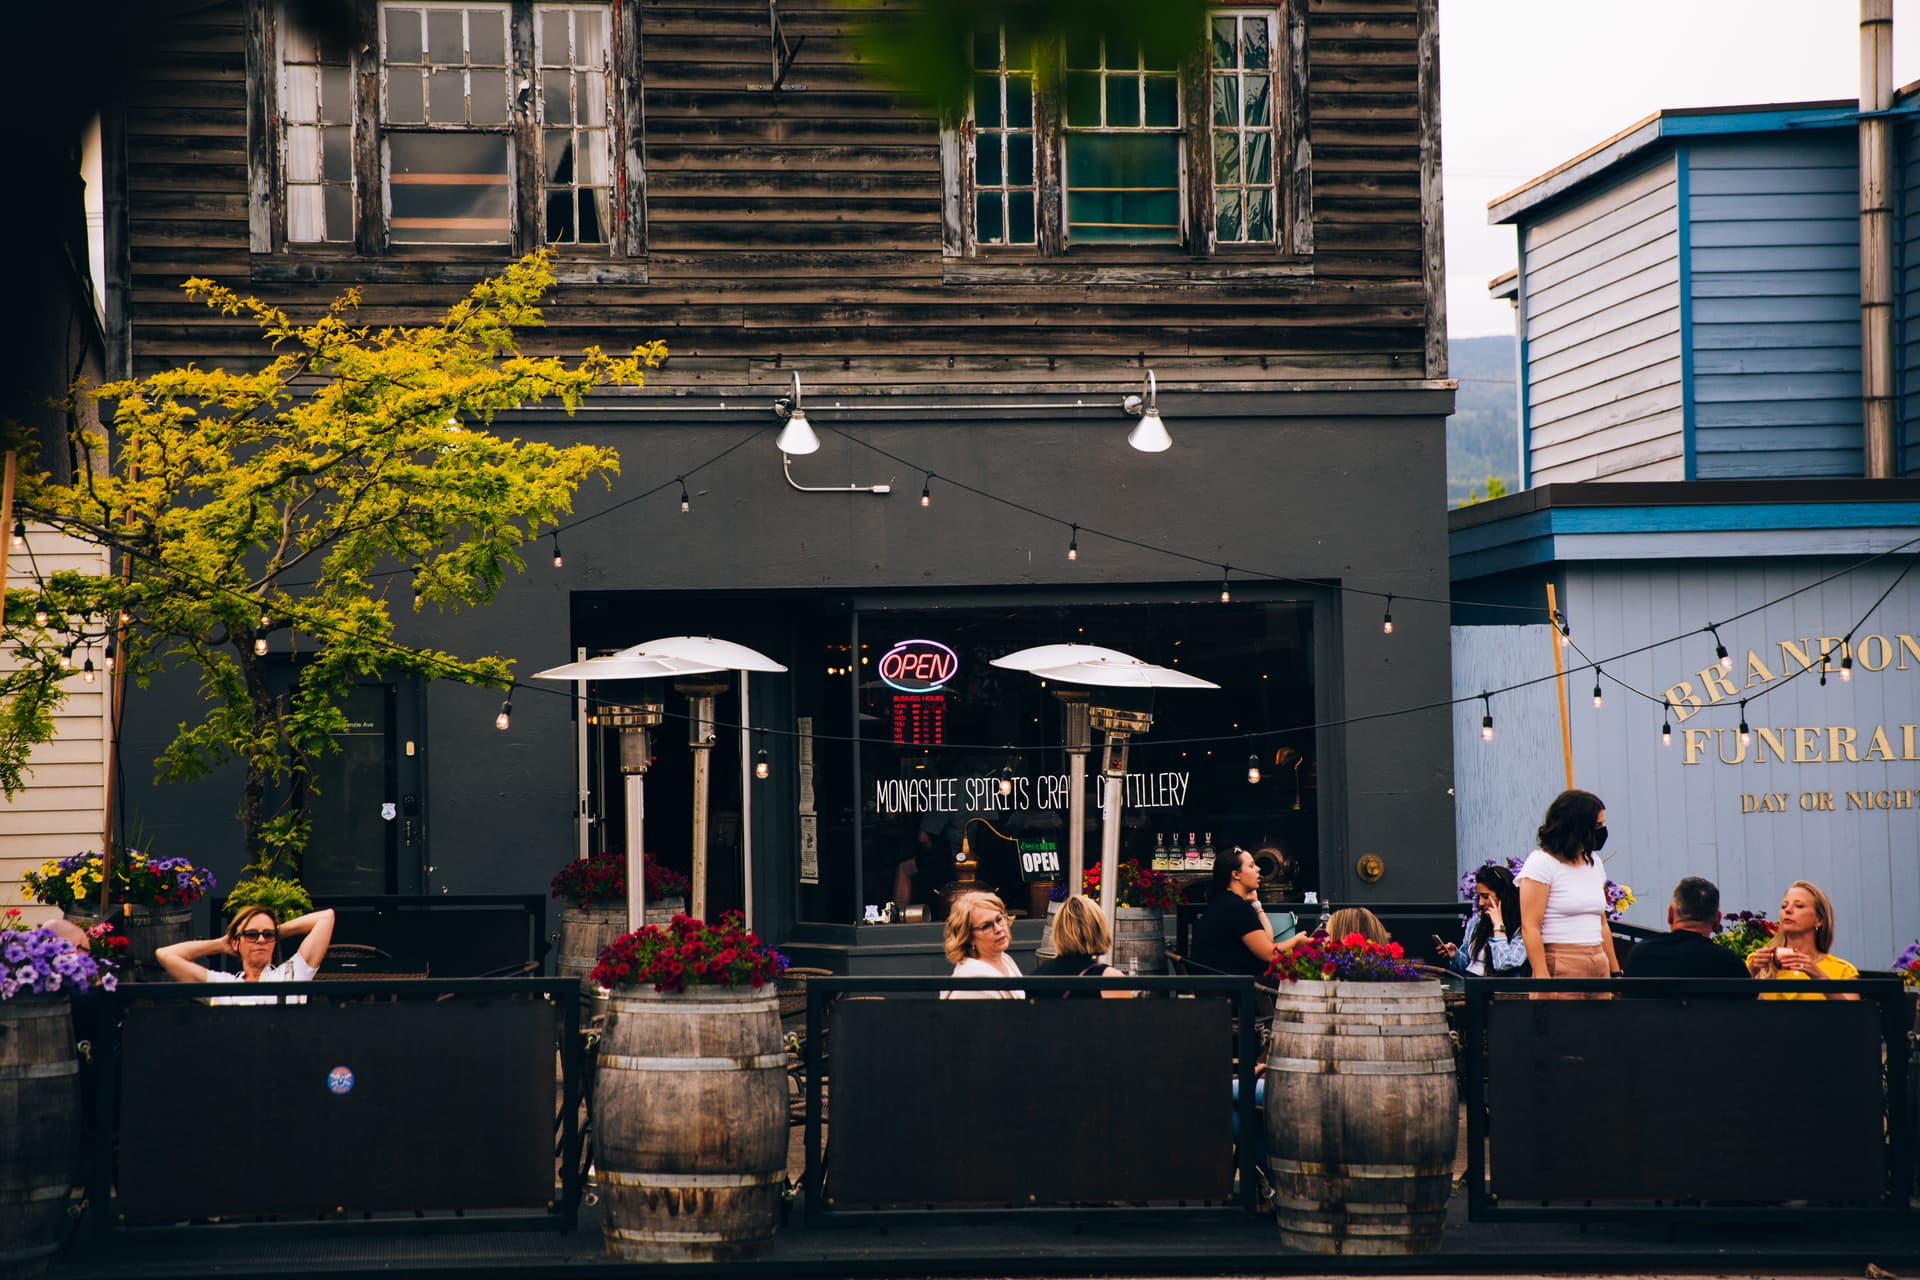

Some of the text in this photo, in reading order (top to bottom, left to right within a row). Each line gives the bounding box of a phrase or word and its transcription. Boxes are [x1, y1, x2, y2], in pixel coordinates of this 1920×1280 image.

[883, 653, 951, 679] OPEN
[1660, 633, 1920, 724] BRANDON
[876, 778, 959, 813] MONASHEE
[1037, 774, 1089, 810] CRA
[1097, 771, 1190, 809] DTILLERY
[1741, 792, 1791, 813] DAY
[1799, 791, 1835, 811] OR
[1022, 852, 1060, 873] OPEN
